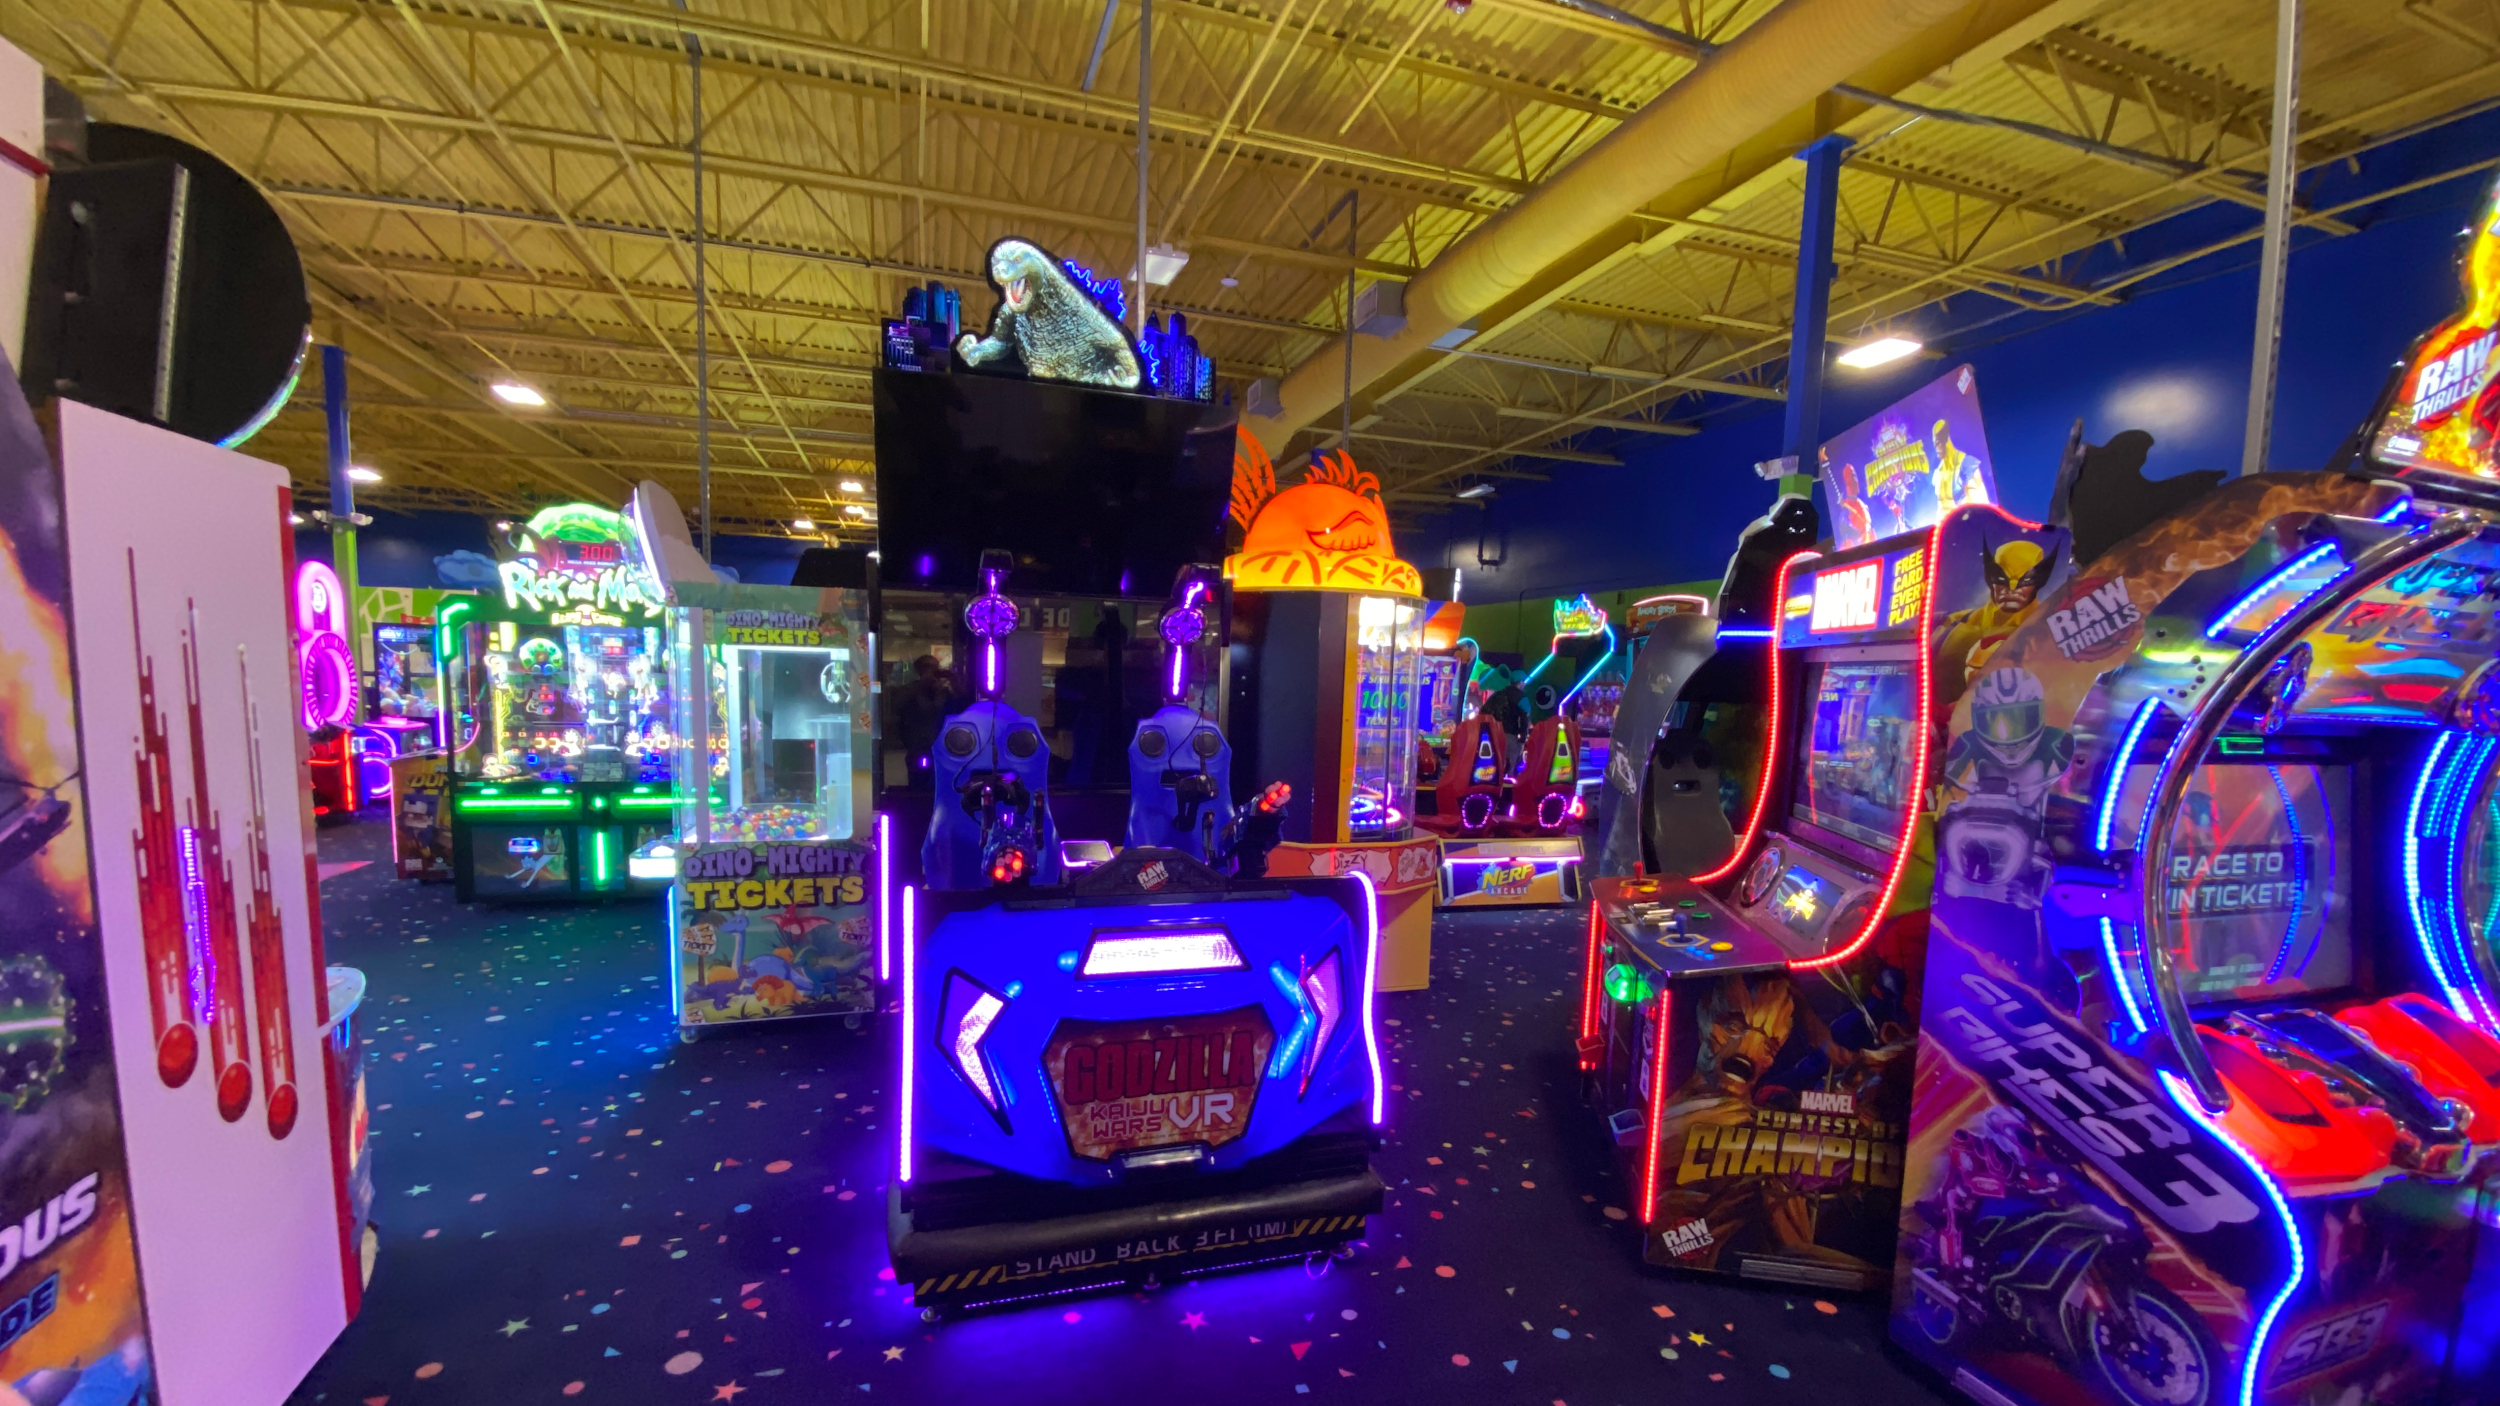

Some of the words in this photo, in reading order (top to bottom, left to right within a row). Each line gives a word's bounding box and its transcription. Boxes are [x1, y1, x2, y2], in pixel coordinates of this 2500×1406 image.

[2414, 331, 2497, 403] RAW
[2411, 369, 2485, 424] THRILLS
[580, 544, 613, 562] 300
[1895, 548, 1924, 577] FREE
[1893, 566, 1924, 593] CARD
[1891, 581, 1929, 611] EVERY
[2046, 575, 2130, 643] RAW
[726, 610, 820, 628] DINO-MIGHTY
[2057, 603, 2141, 658] THRILLS
[727, 627, 822, 645] TICKETS
[1362, 689, 1410, 710] 1000
[684, 845, 866, 878] DINO-MIGHTY
[1137, 861, 1165, 885] RAW
[2172, 853, 2248, 878] RACE
[2252, 852, 2284, 873] TO
[1482, 863, 1534, 890] NERF
[686, 876, 864, 910] TICKETS
[1490, 886, 1528, 896] ARCADE
[683, 940, 713, 952] TICKET
[1064, 1031, 1256, 1105] GODZILLA
[1960, 973, 2192, 1149] SUPER
[1090, 1098, 1165, 1122] KAIJU
[1168, 1092, 1235, 1129] VR
[1801, 1091, 1854, 1114] MARVEL
[1093, 1116, 1162, 1139] WARS
[1756, 1110, 1860, 1136] CONTEST
[1662, 1217, 1708, 1248] RAW
[1669, 1233, 1714, 1257] THRILLS
[1016, 1248, 1096, 1274] STAND
[1116, 1235, 1181, 1259] BACK
